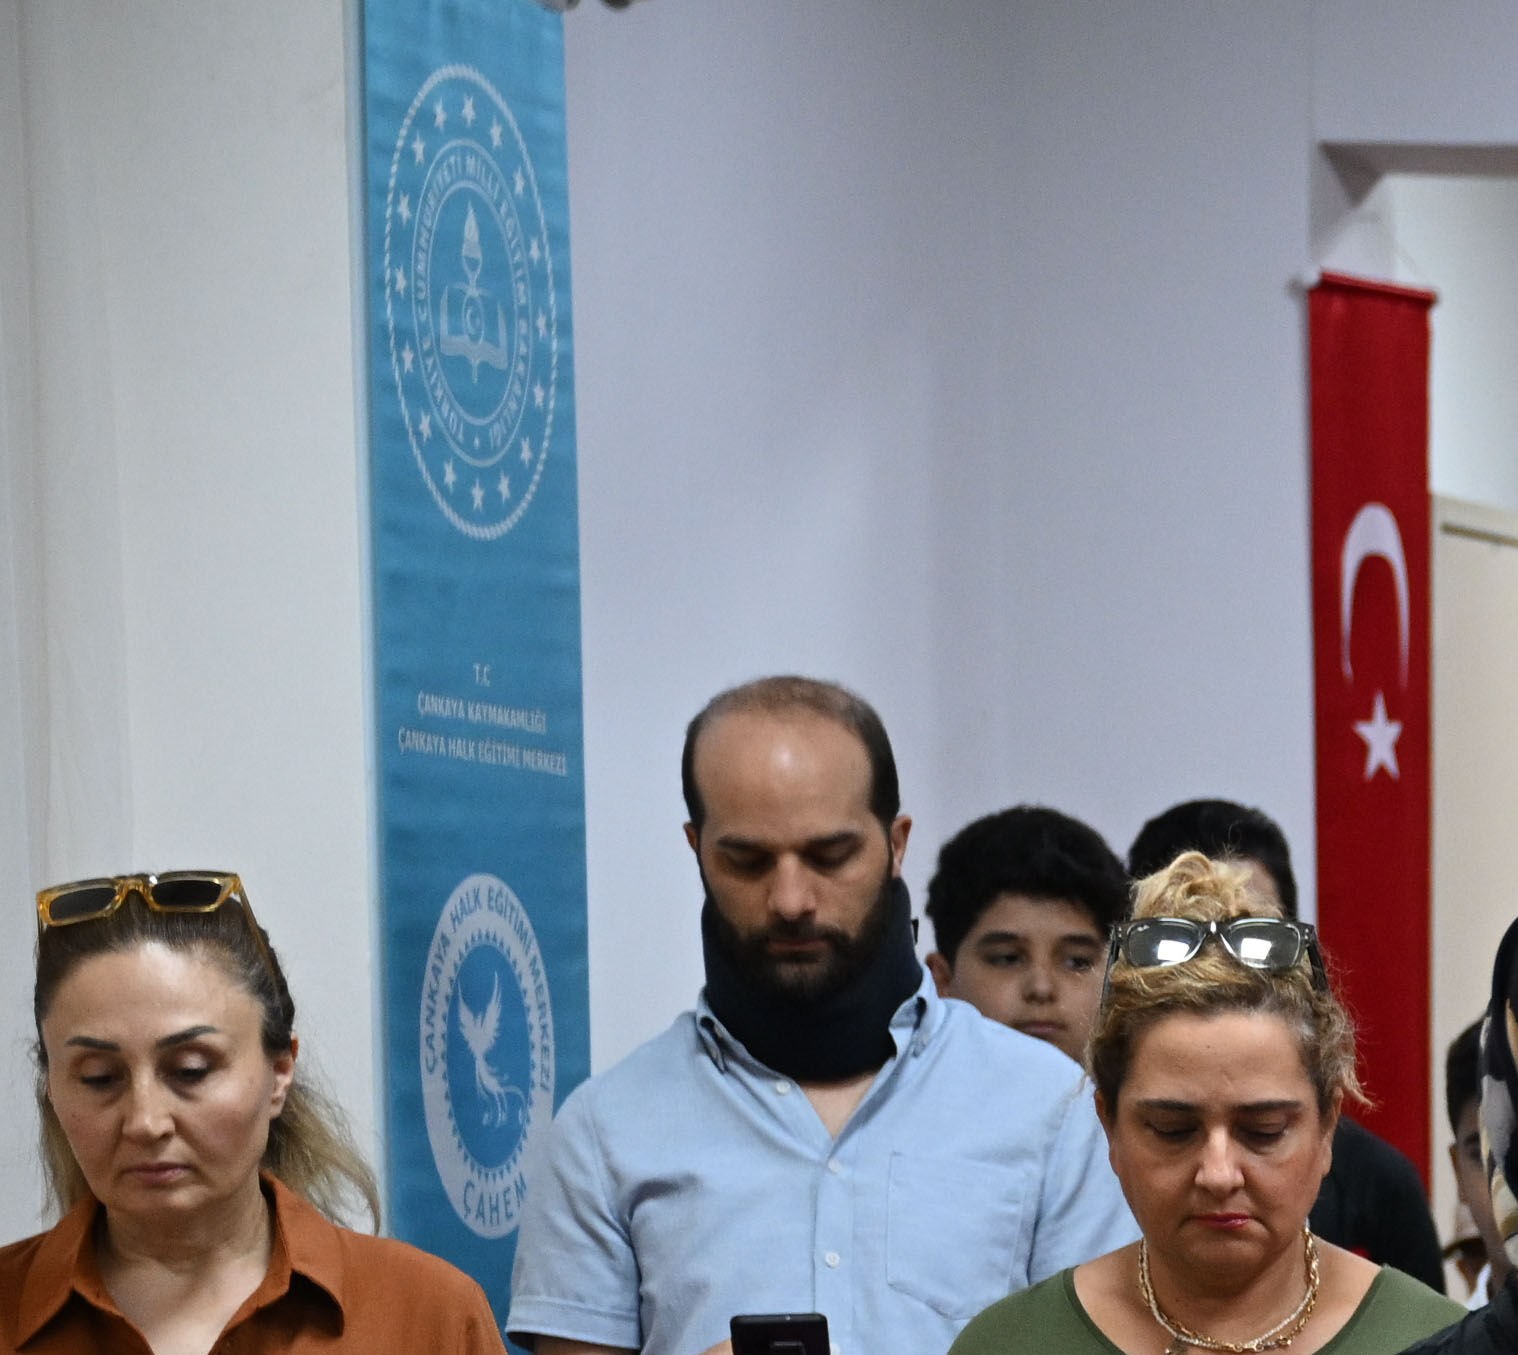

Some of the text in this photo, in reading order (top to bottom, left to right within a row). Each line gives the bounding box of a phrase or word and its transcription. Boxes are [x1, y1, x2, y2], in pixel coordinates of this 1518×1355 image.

[417, 690, 466, 720] ÇANKAYA
[398, 726, 447, 755] ÇANKAYA
[448, 736, 476, 761] HALK
[425, 931, 450, 1074] ÇANKAYA
[450, 887, 482, 933] HALK
